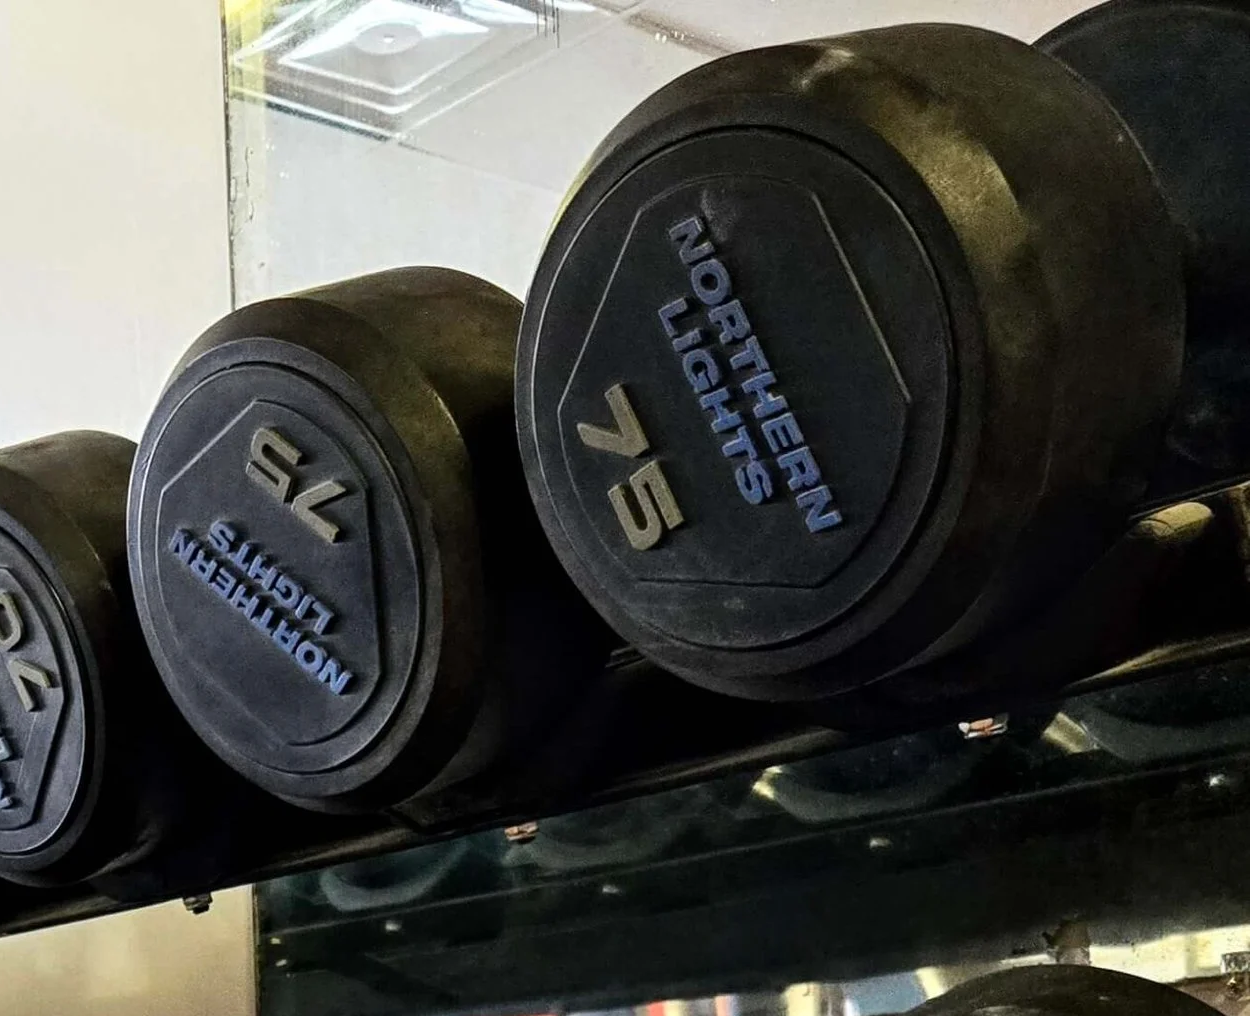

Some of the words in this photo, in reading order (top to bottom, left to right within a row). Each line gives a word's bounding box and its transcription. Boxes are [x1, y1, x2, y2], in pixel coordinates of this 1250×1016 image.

[658, 298, 773, 504] LIGHTS
[668, 215, 843, 533] NORTHERN
[246, 427, 348, 543] 75
[577, 383, 684, 551] 75
[169, 528, 352, 696] NORTHERN
[207, 520, 335, 635] LIGHTS
